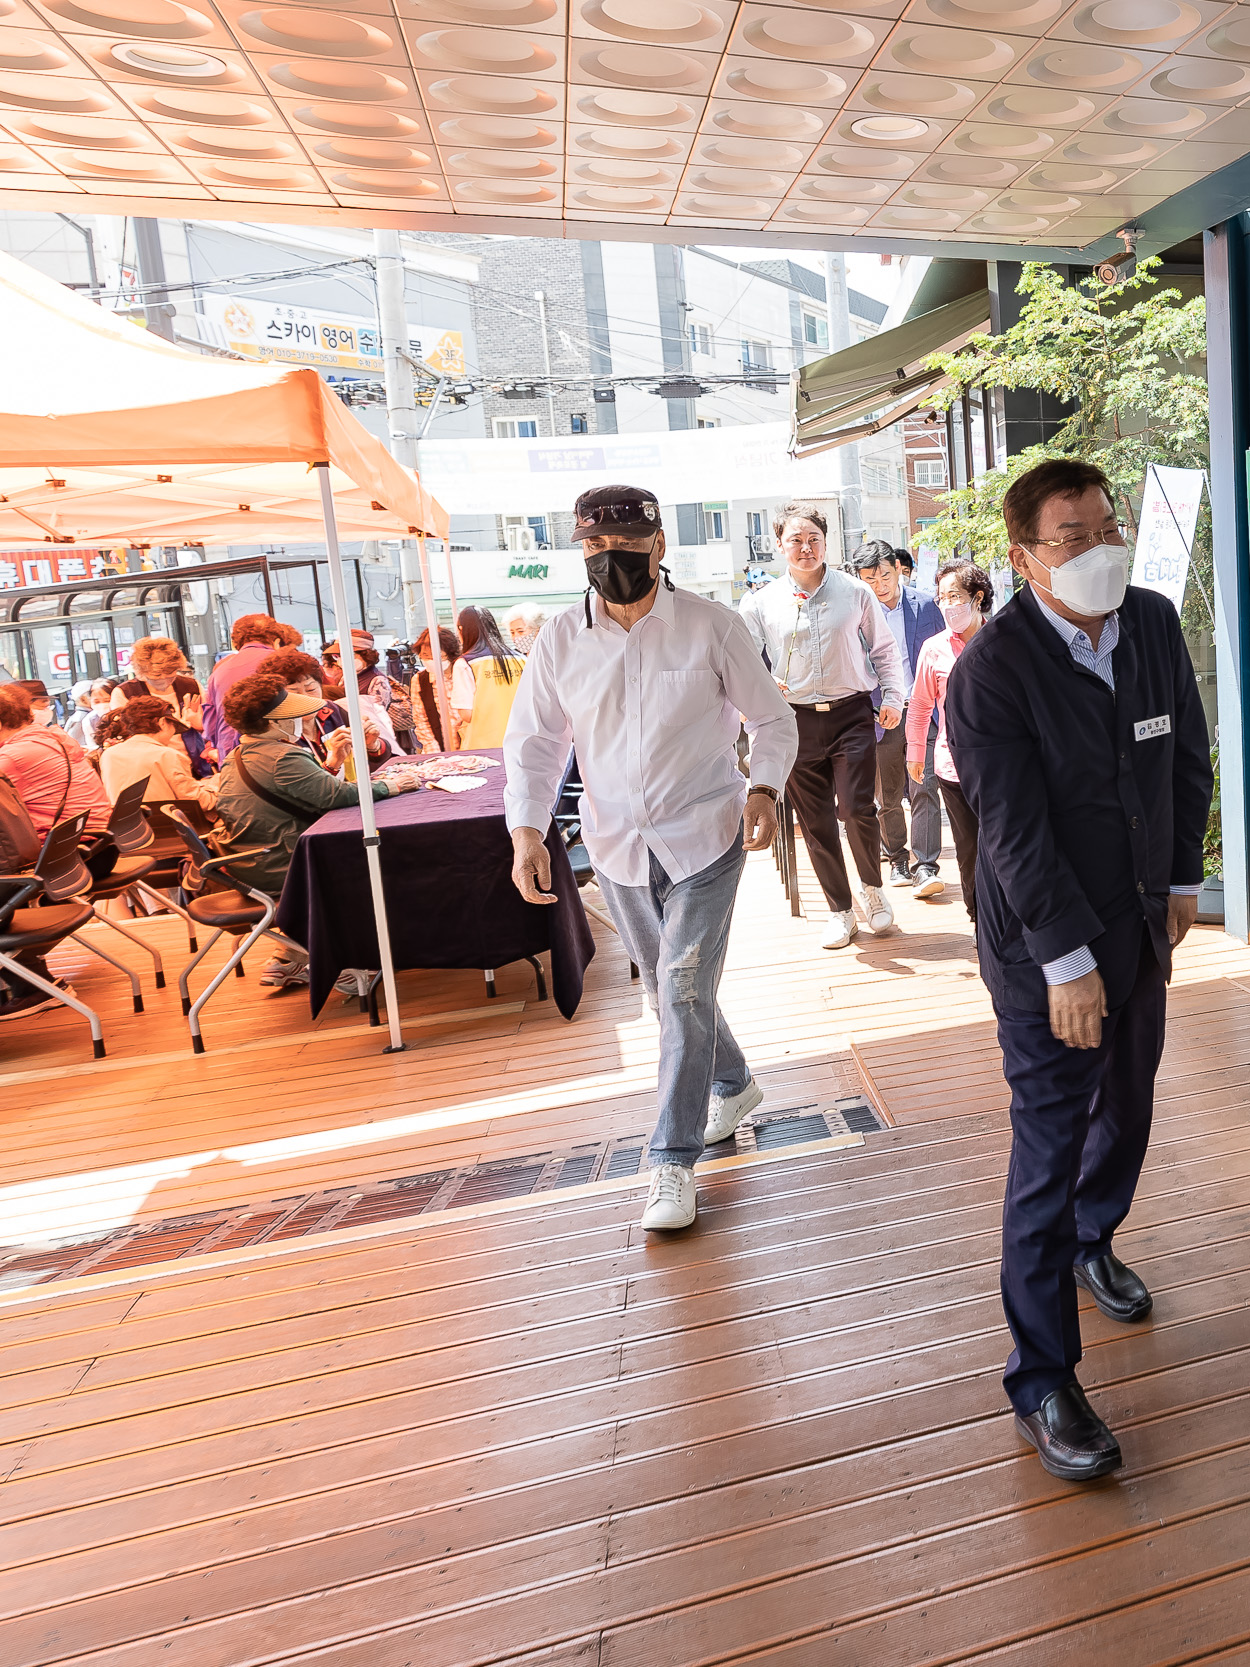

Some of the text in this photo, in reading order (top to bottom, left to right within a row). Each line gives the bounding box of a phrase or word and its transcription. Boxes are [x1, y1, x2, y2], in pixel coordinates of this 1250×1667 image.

[267, 320, 317, 345] 스카이
[322, 326, 355, 350] 영어
[258, 346, 275, 356] 영어
[276, 348, 338, 364] 010-3719-0530
[508, 564, 549, 580] MARI
